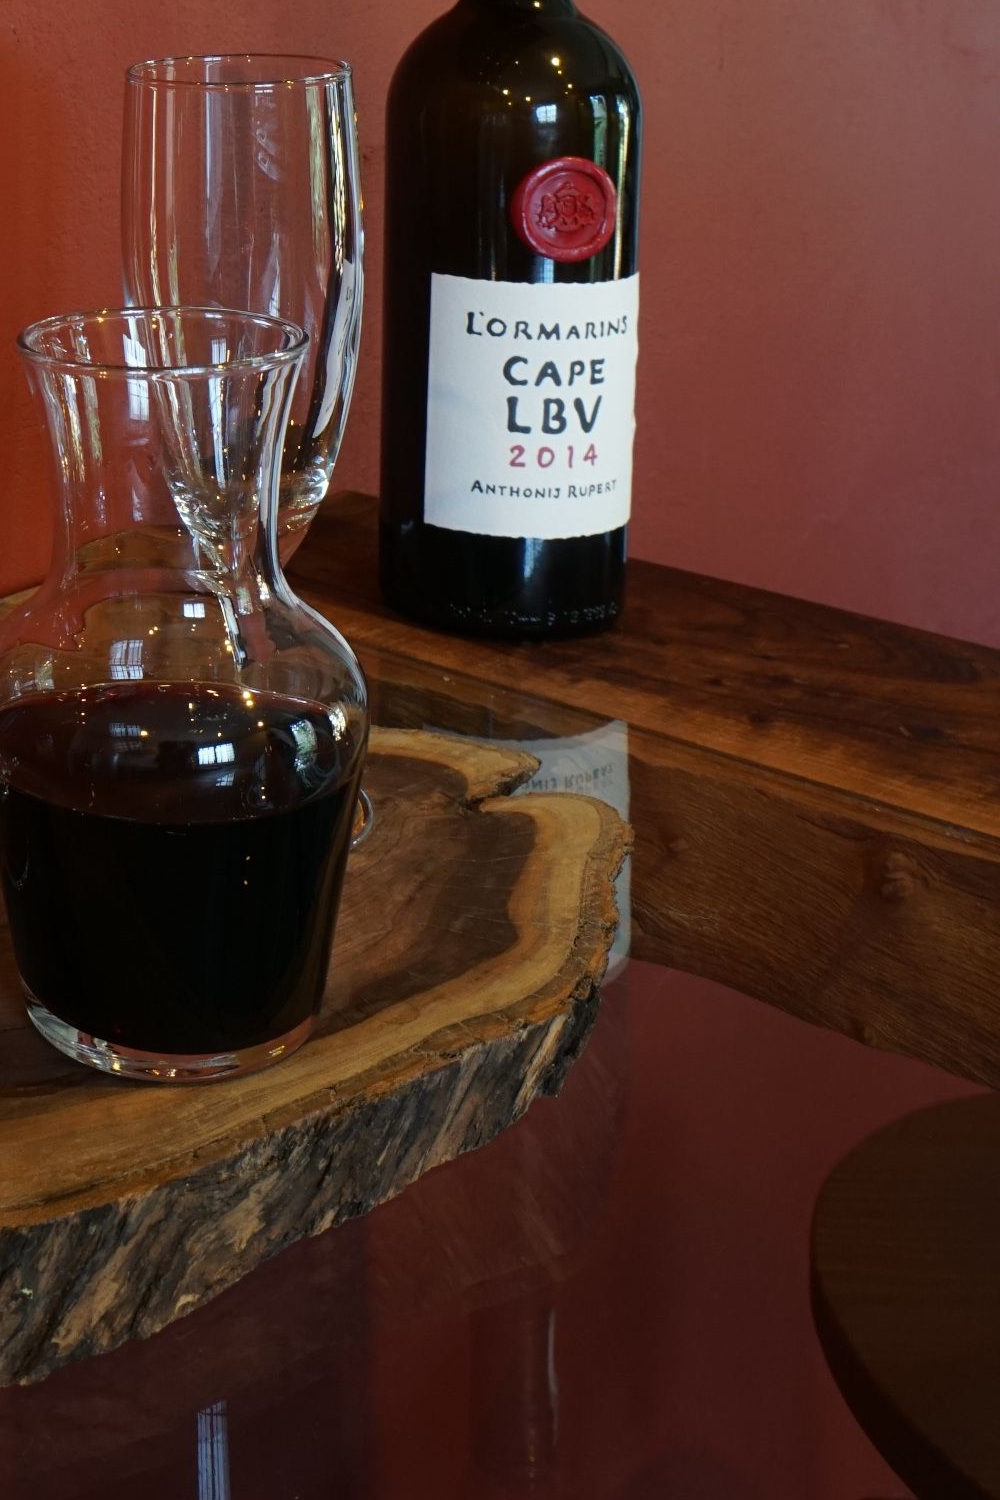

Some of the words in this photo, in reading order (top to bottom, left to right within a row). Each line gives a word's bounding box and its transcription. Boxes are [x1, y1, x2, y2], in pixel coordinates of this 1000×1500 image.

[466, 311, 628, 340] L'ORMARINS
[503, 355, 606, 387] CAPE
[506, 395, 602, 435] LBV
[509, 443, 598, 469] 2014
[470, 479, 561, 500] ANTHONIJ
[567, 479, 618, 499] RUPERT
